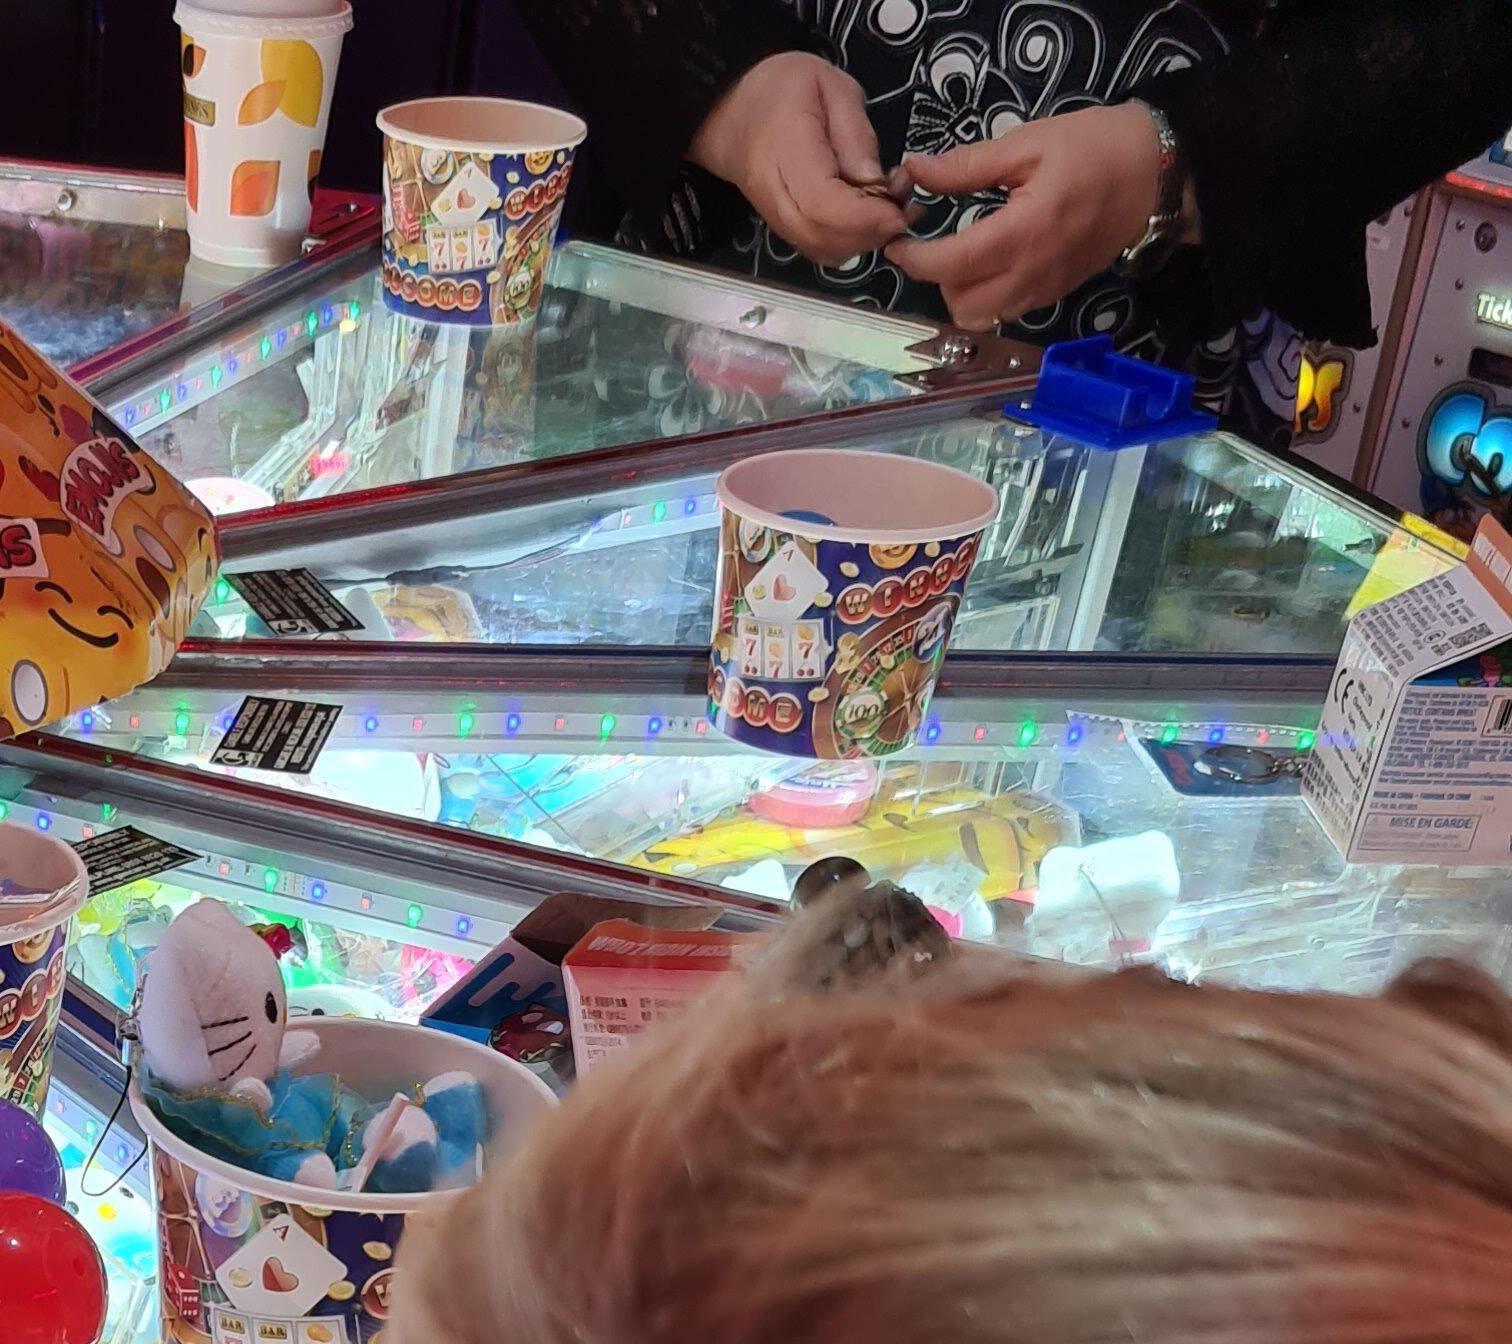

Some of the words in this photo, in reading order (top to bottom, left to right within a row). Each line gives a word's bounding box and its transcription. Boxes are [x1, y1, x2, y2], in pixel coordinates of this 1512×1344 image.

[848, 702, 879, 718] 100
[221, 1317, 244, 1332] BAR
[260, 1325, 286, 1338] BAR
